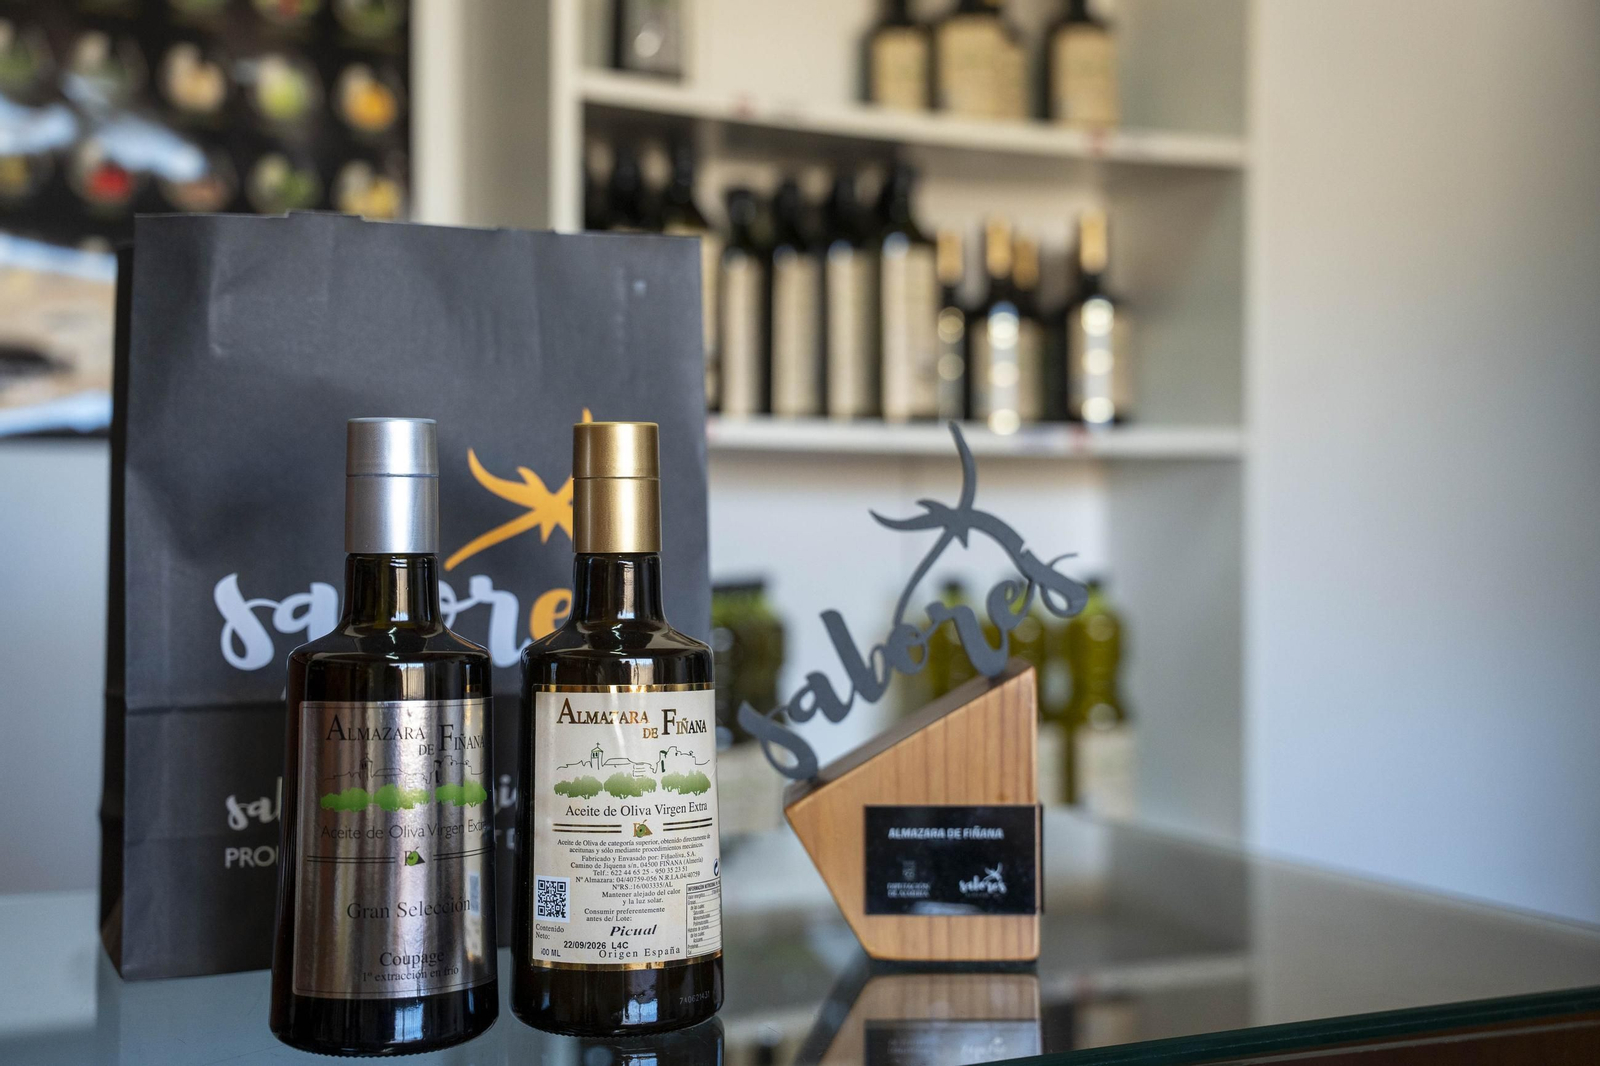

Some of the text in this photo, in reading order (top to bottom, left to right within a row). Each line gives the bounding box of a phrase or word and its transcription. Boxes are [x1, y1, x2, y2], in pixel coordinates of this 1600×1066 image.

[737, 549, 1088, 780] sabores
[557, 698, 707, 739] ALMAZARA DE FIÑANA
[326, 714, 425, 741] ALMAZARA
[419, 744, 434, 755] DE
[566, 802, 708, 817] Aceite de Oliva Virgen Extra
[321, 826, 360, 839] Aceite
[367, 826, 384, 839] de
[389, 825, 425, 839] Oliva
[427, 823, 464, 839] Virgen
[888, 825, 1004, 839] ALMAZARA DE FIÑANA
[642, 845, 681, 854] procedimientos
[634, 890, 655, 898] alejado
[347, 899, 470, 919] Gran Selección
[616, 907, 665, 917] preferentemente
[536, 924, 565, 933] Contenido
[610, 924, 658, 937] Picual
[536, 932, 550, 940] Neto:
[564, 940, 629, 950] 22/09/2026 L4C
[551, 949, 561, 957] ML
[599, 950, 638, 960] Origen
[644, 947, 680, 958] España
[380, 950, 445, 970] Coupage
[375, 970, 427, 981] extracción
[430, 969, 441, 979] en
[444, 966, 459, 976] frío
